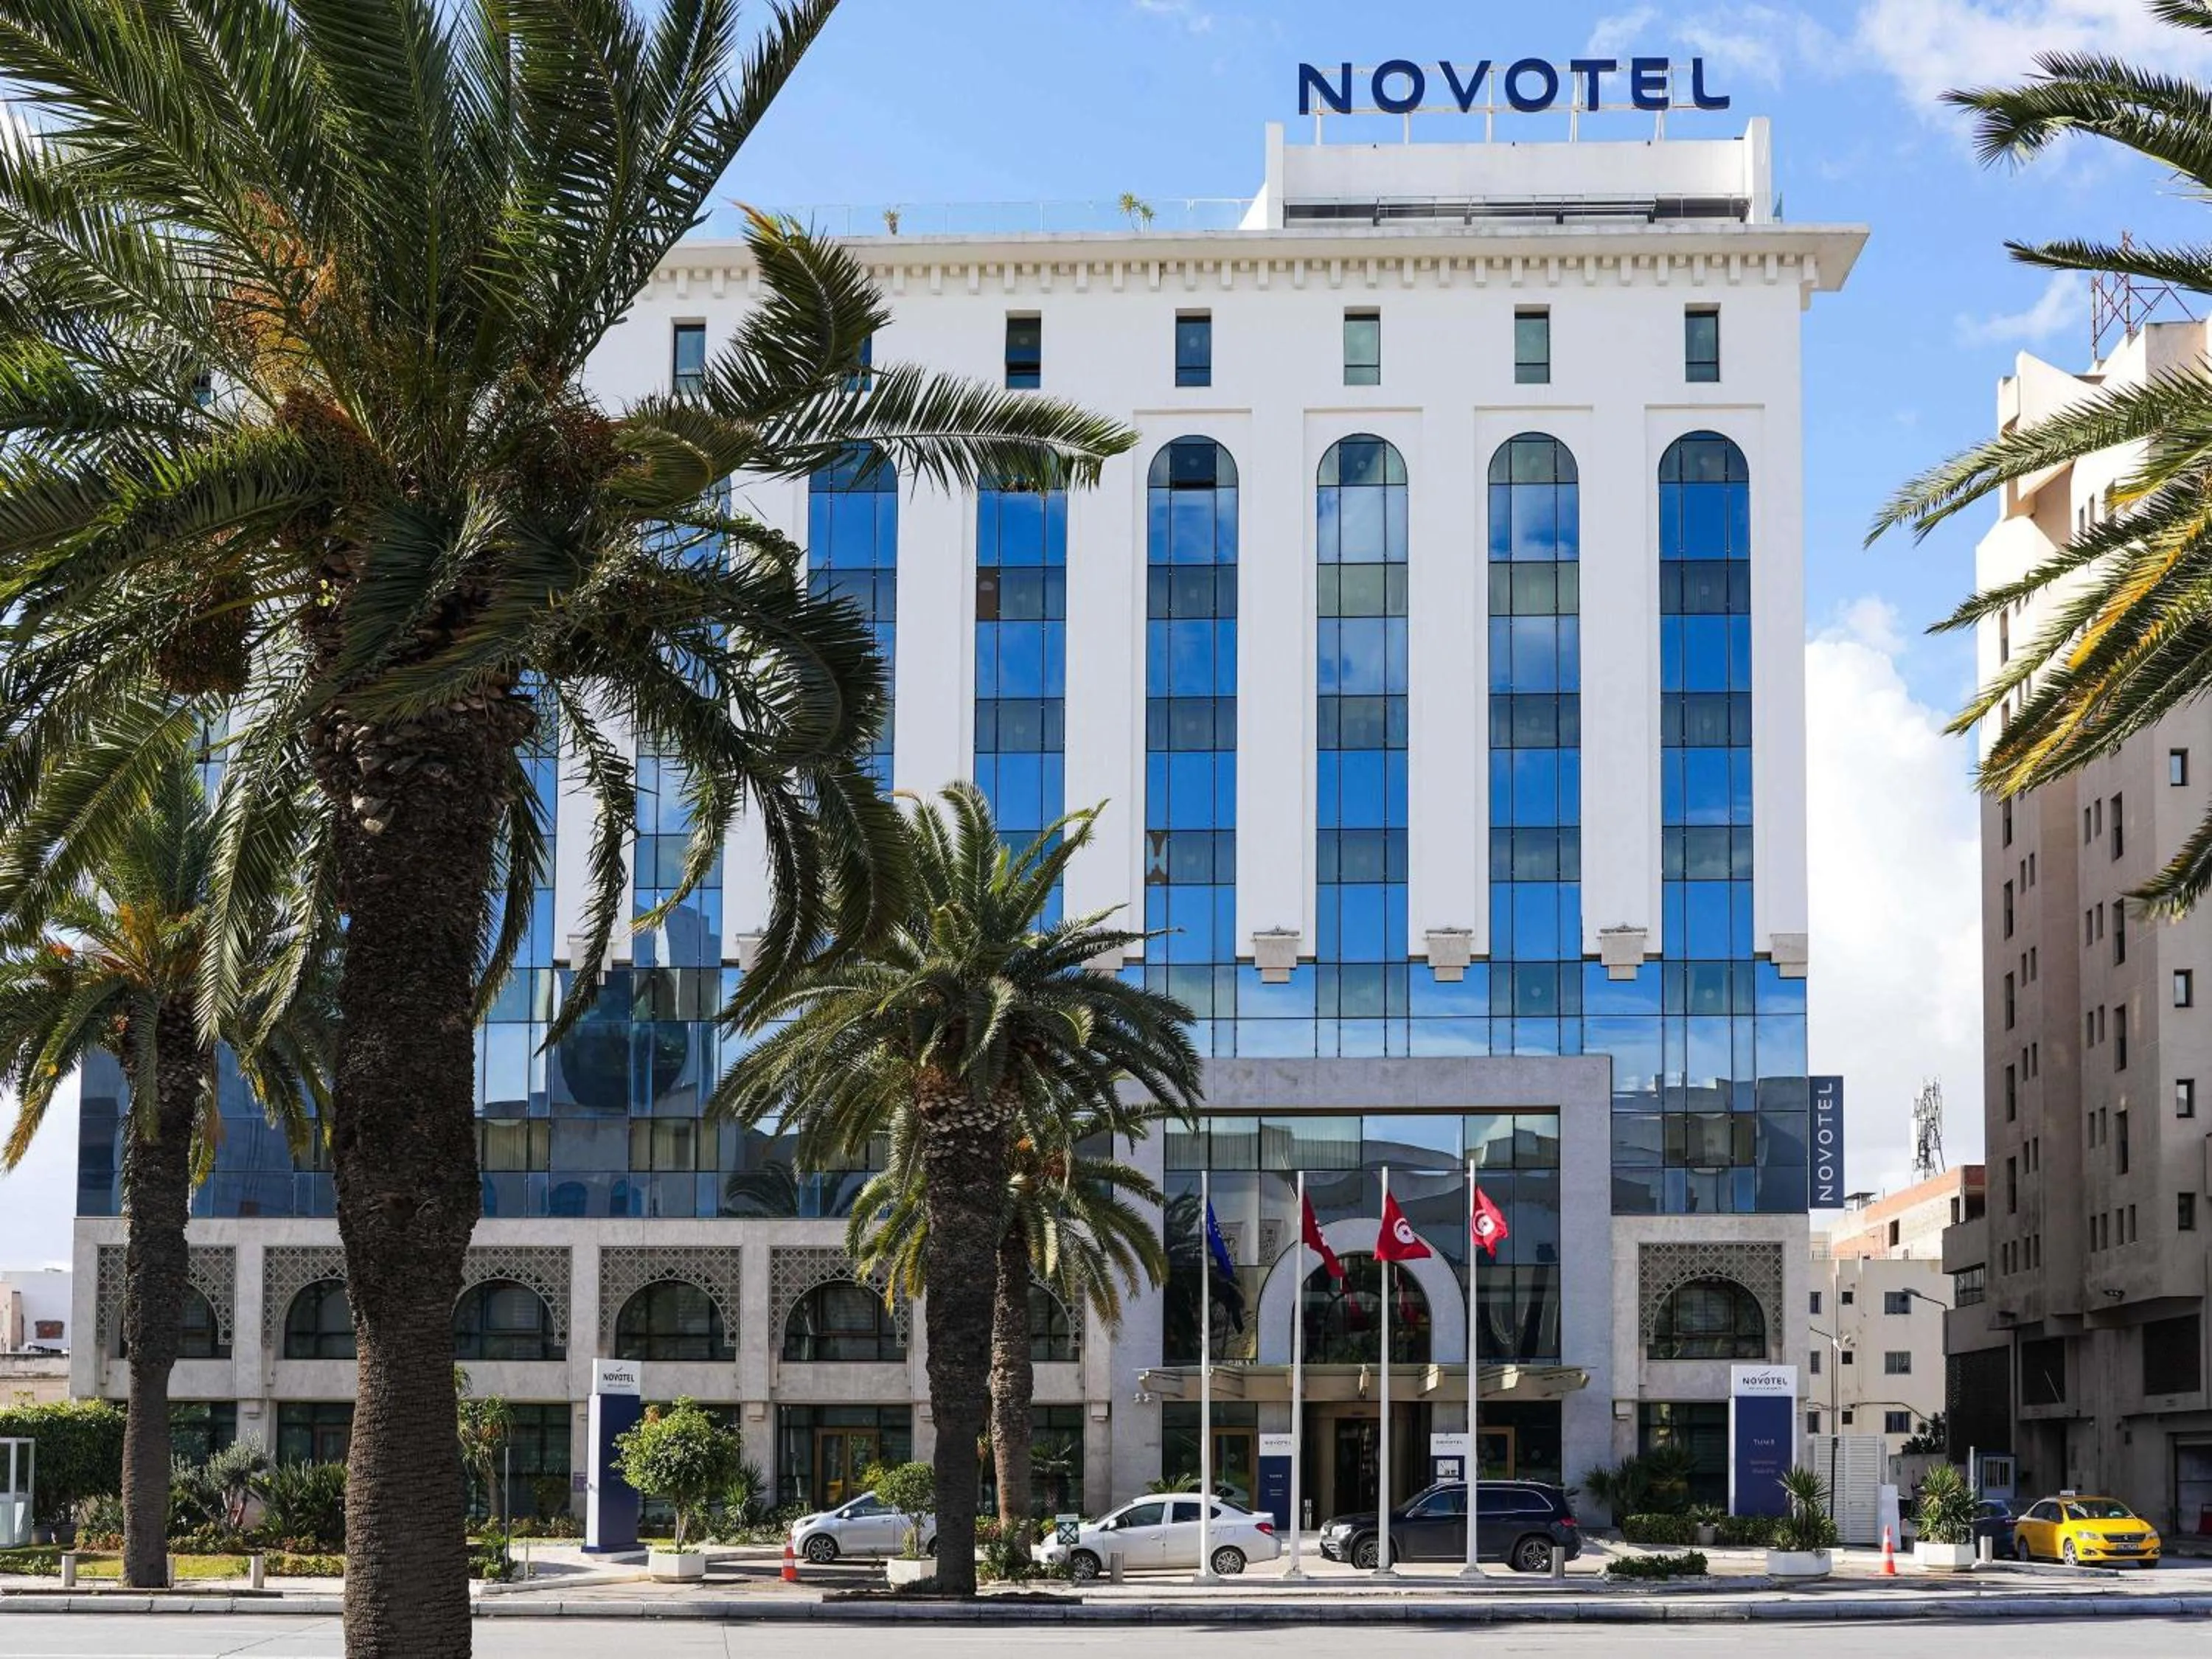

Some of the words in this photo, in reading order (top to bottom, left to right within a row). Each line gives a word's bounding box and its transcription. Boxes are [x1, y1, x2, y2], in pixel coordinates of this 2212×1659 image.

[1298, 58, 1731, 115] NOVOTEL
[1818, 1082, 1834, 1201] NOVOTEL
[602, 1372, 635, 1382] NOVOTEL
[1742, 1377, 1788, 1386] NOVOTEL
